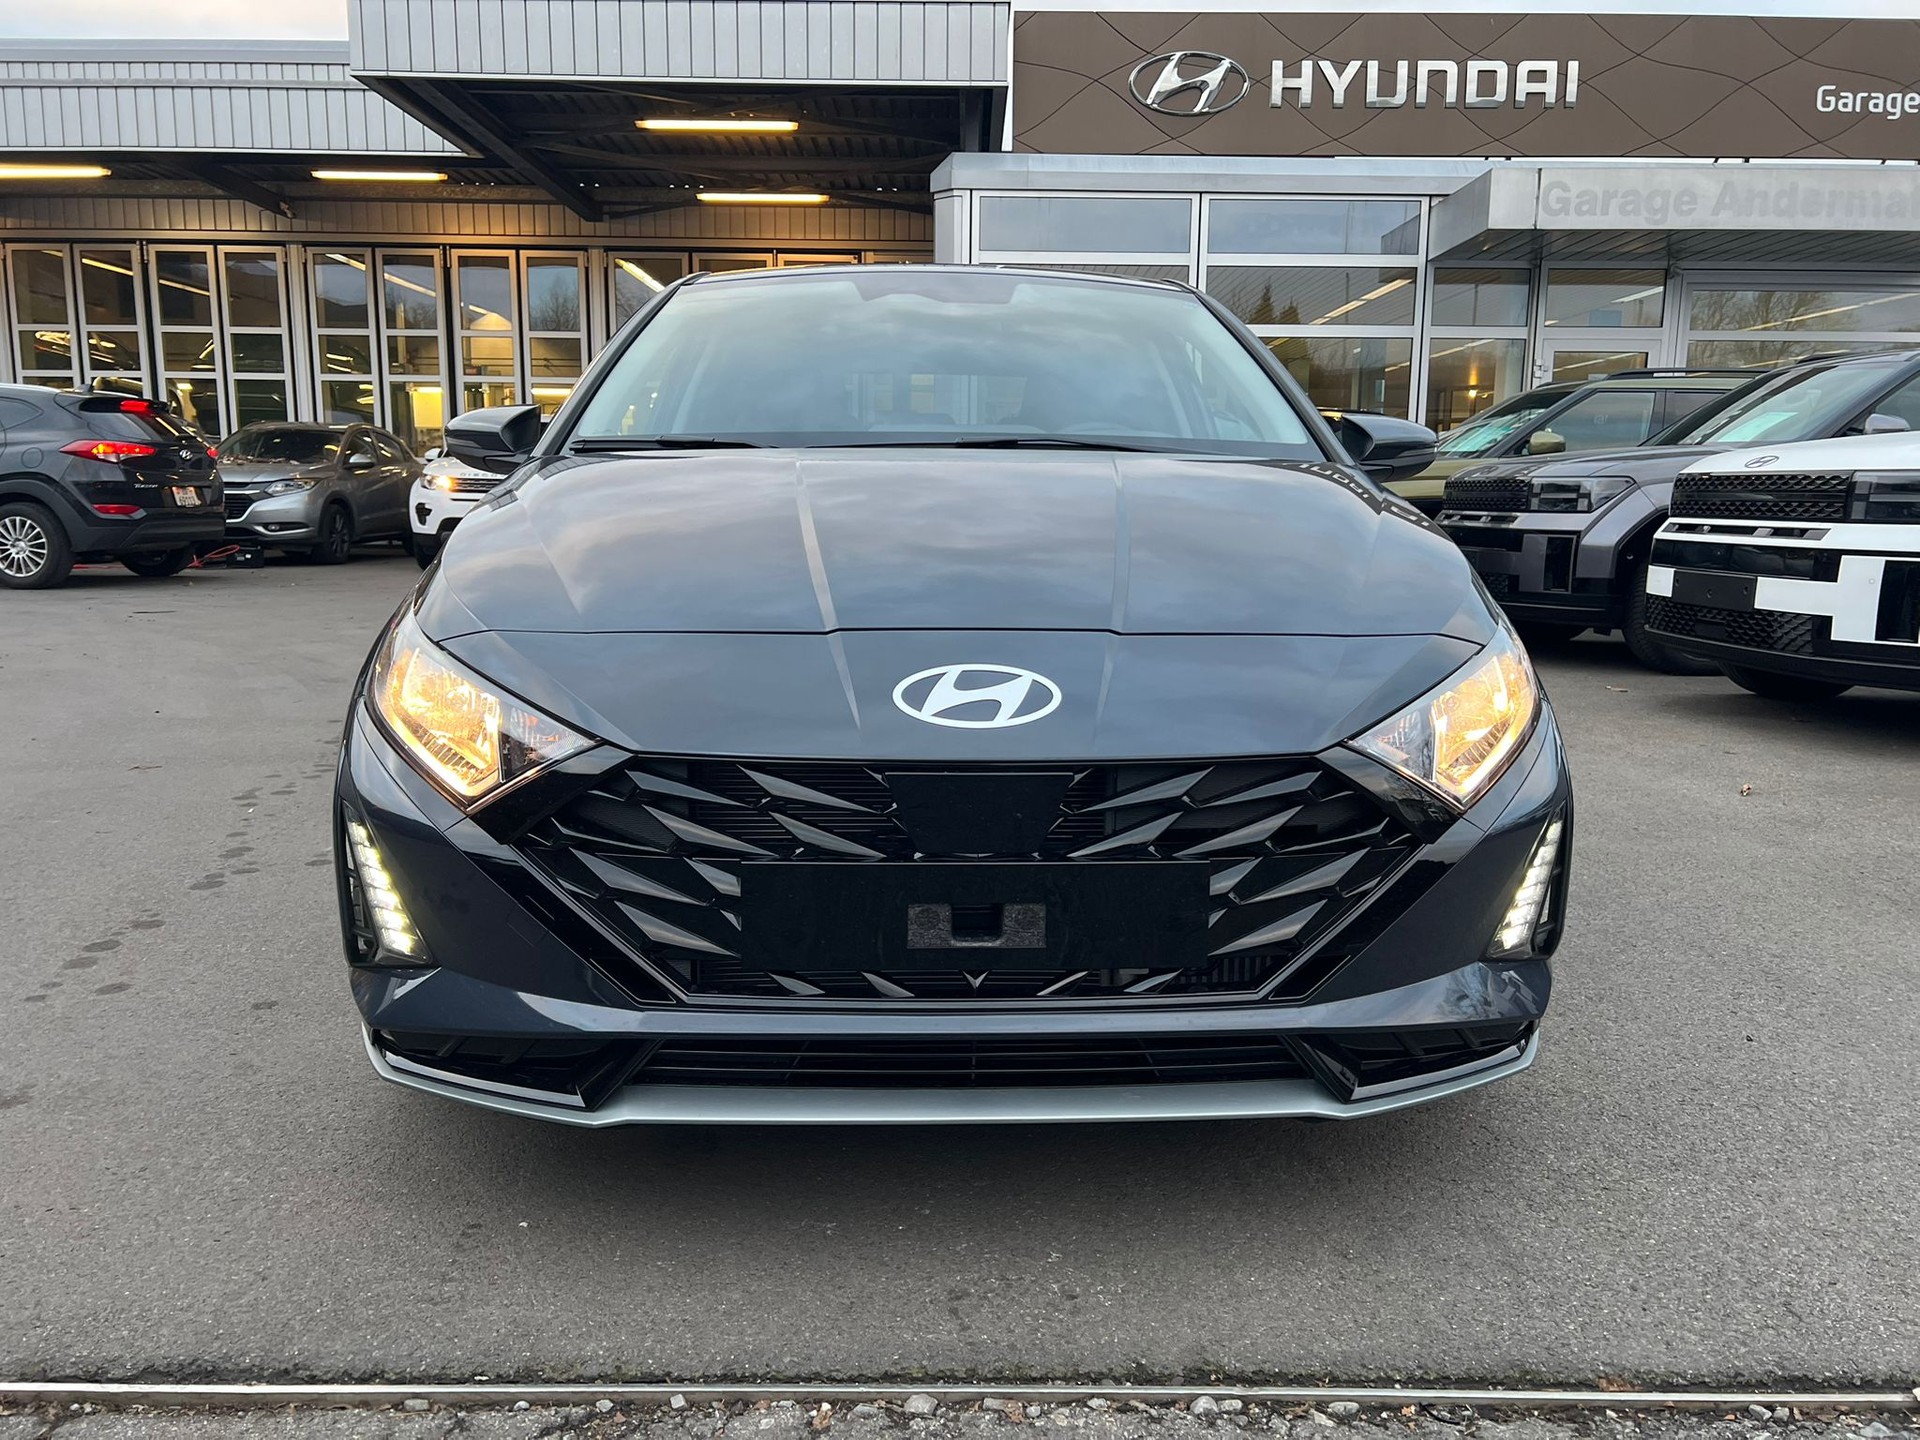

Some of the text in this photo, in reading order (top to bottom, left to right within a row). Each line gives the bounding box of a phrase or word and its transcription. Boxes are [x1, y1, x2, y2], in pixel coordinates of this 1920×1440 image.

[1270, 59, 1580, 109] HYUNDAI
[1816, 84, 1920, 120] Garage
[1541, 180, 1698, 226] Garage
